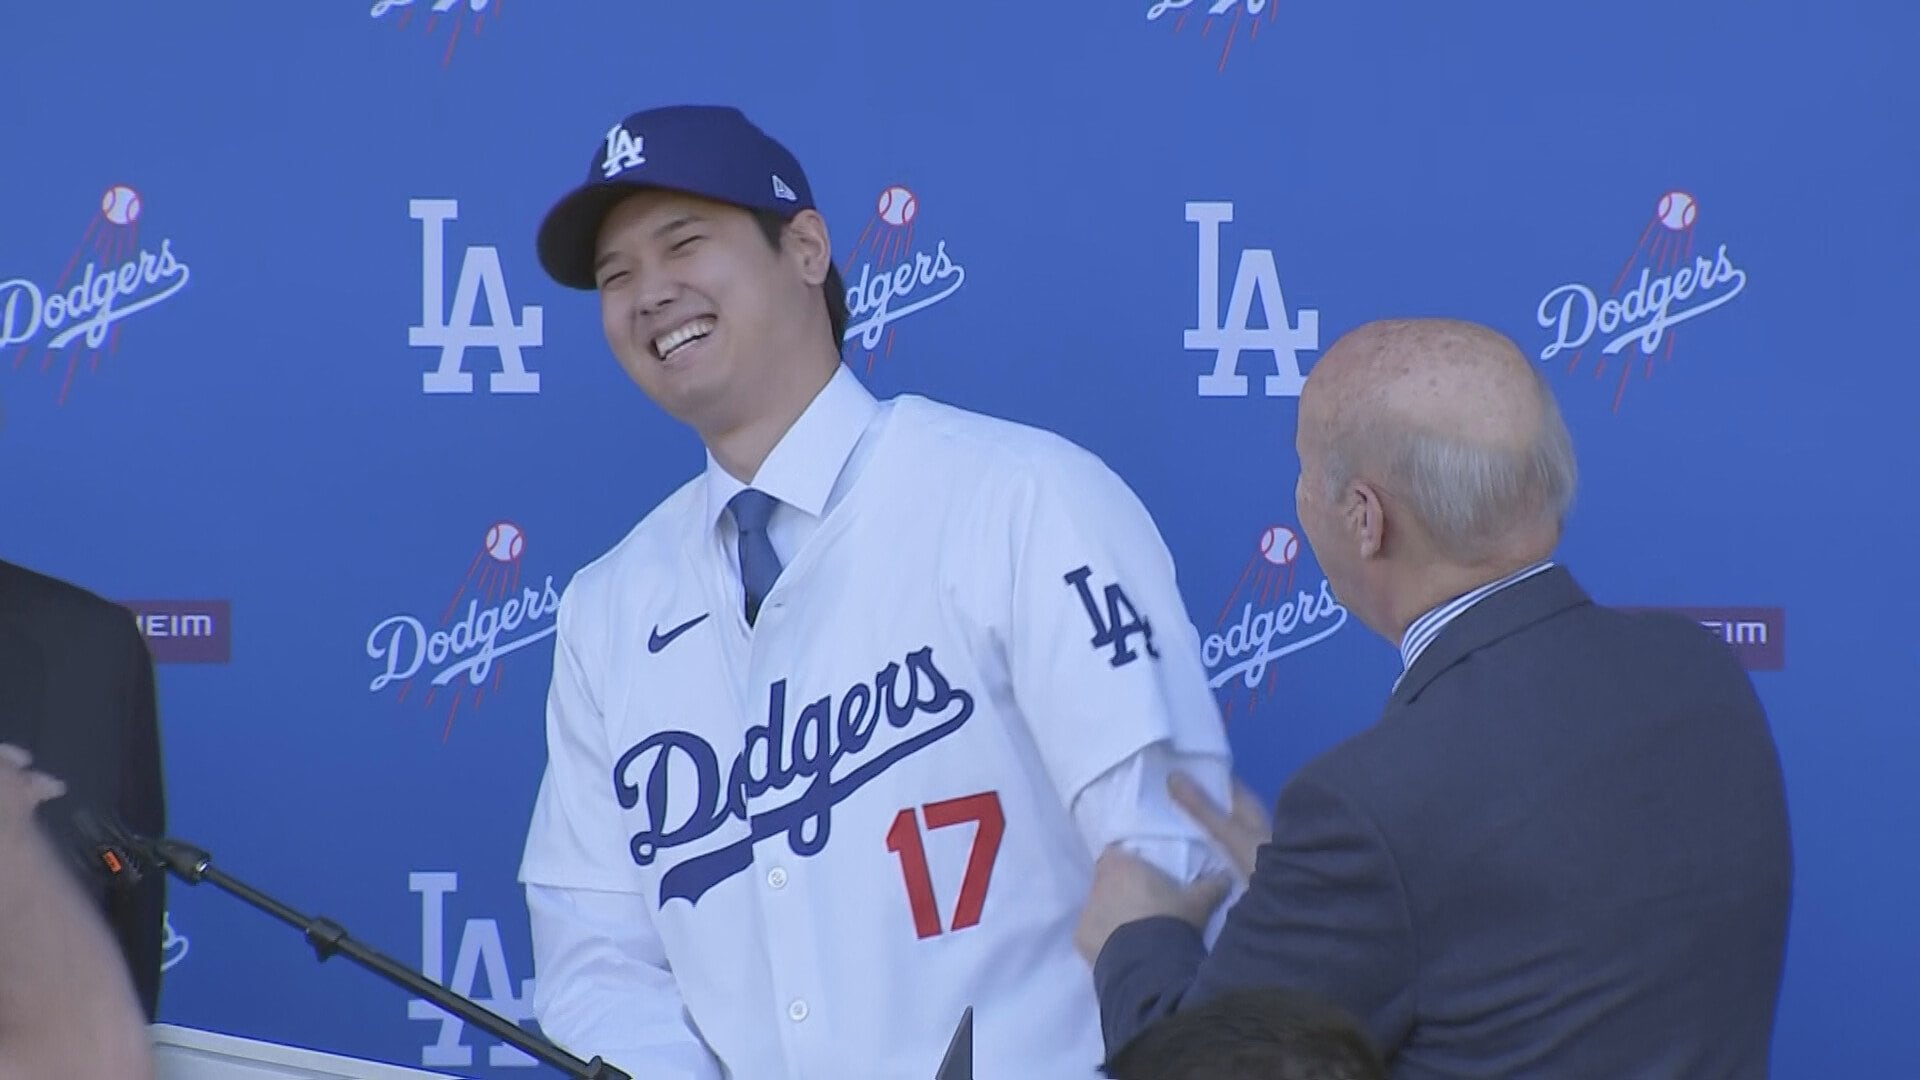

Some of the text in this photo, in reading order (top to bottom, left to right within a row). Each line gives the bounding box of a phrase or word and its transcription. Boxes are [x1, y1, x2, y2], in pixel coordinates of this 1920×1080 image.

[602, 123, 646, 178] LA
[0, 238, 190, 349] Dodgers
[409, 199, 543, 393] LA
[843, 239, 965, 350] dgers
[1183, 202, 1319, 396] LA
[1537, 244, 1747, 359] Dodgers
[366, 574, 561, 692] Dodgers
[1063, 564, 1160, 668] LA
[1201, 579, 1348, 689] odgers
[613, 646, 975, 910] Dodgers
[885, 790, 1007, 940] 17
